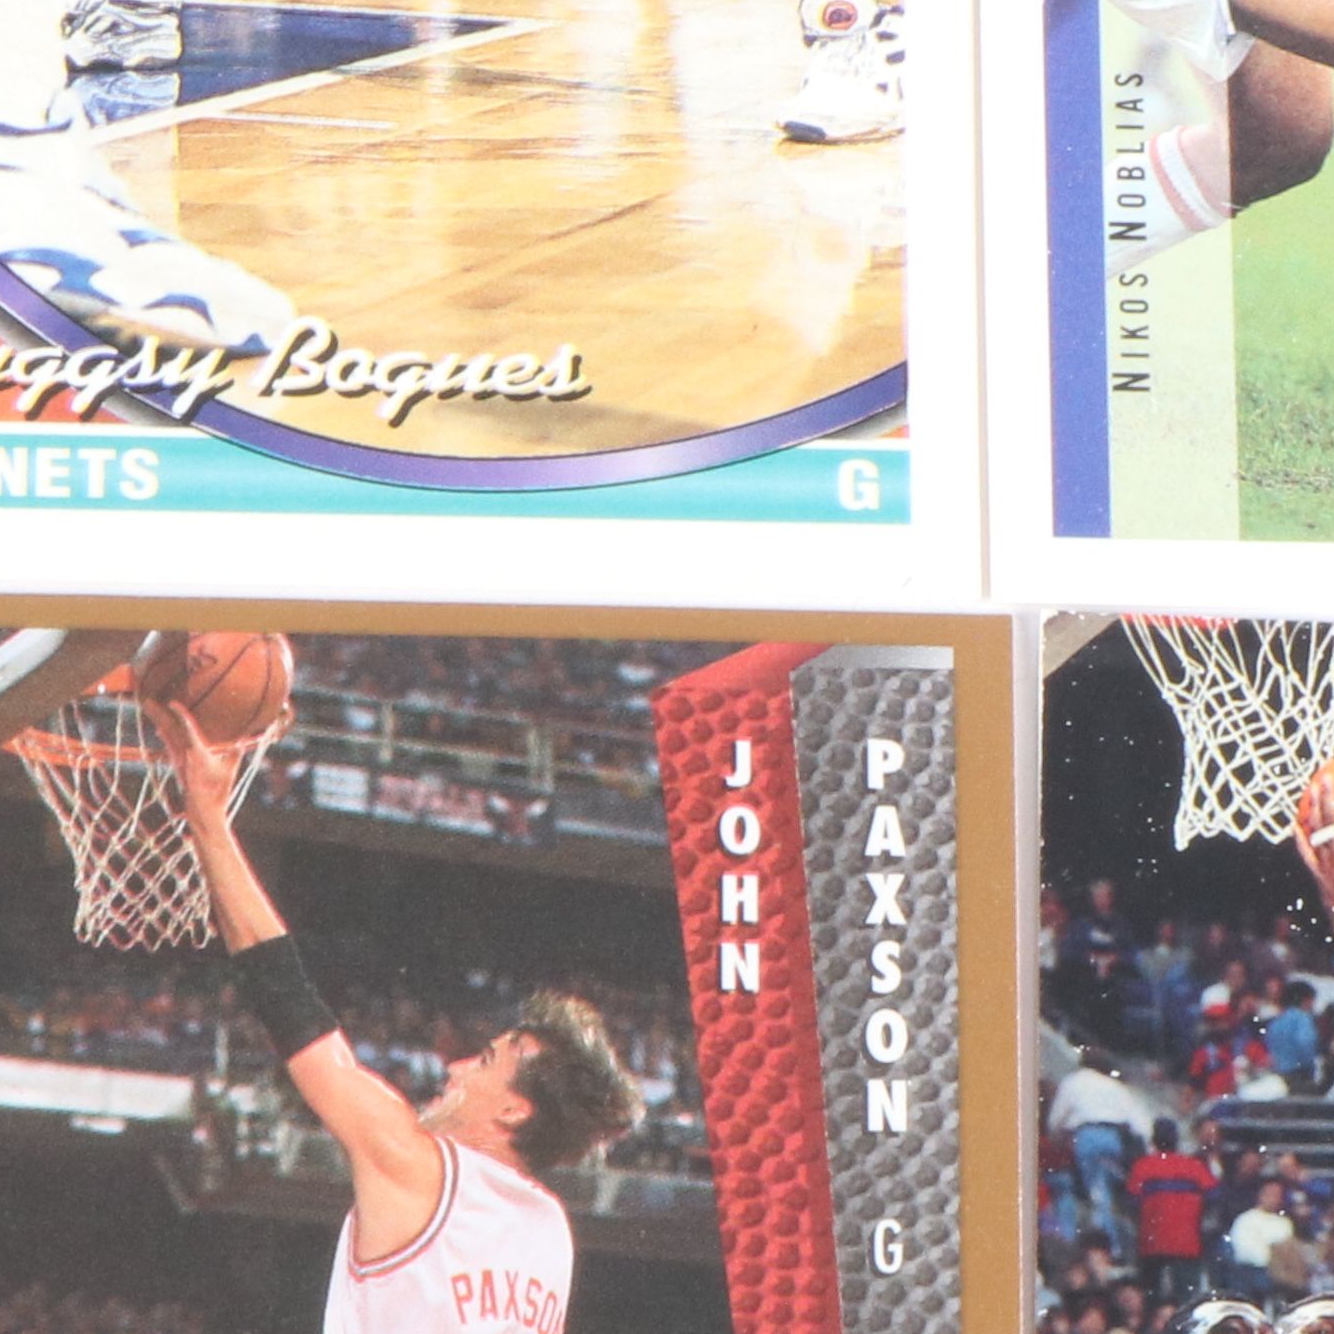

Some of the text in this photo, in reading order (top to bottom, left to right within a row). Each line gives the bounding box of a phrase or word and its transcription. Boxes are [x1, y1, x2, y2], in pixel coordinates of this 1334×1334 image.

[1108, 72, 1151, 392] NIKOS NOBLIAS
[251, 315, 591, 427] Bogues
[838, 458, 882, 511] G
[718, 738, 762, 994] JOHN
[864, 738, 910, 1275] PAXSON G
